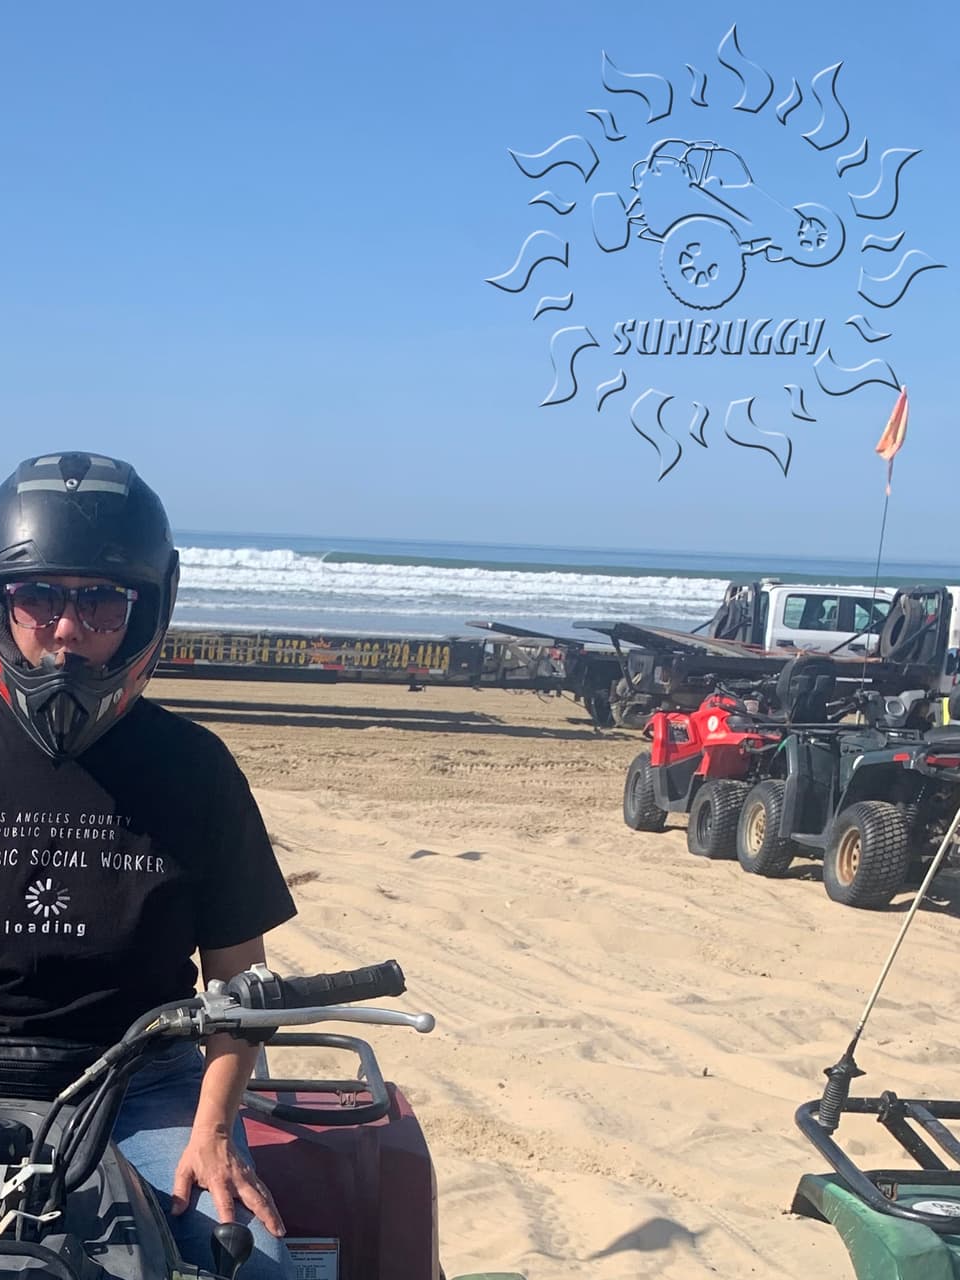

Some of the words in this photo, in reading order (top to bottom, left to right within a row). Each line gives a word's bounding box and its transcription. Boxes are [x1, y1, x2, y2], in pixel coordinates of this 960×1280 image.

[16, 812, 70, 824] ANGELES
[80, 814, 133, 827] COUNTY
[50, 828, 116, 840] DEFENDER
[30, 849, 88, 868] SOCIAL
[101, 851, 165, 873] WORKER
[4, 920, 87, 937] loading
